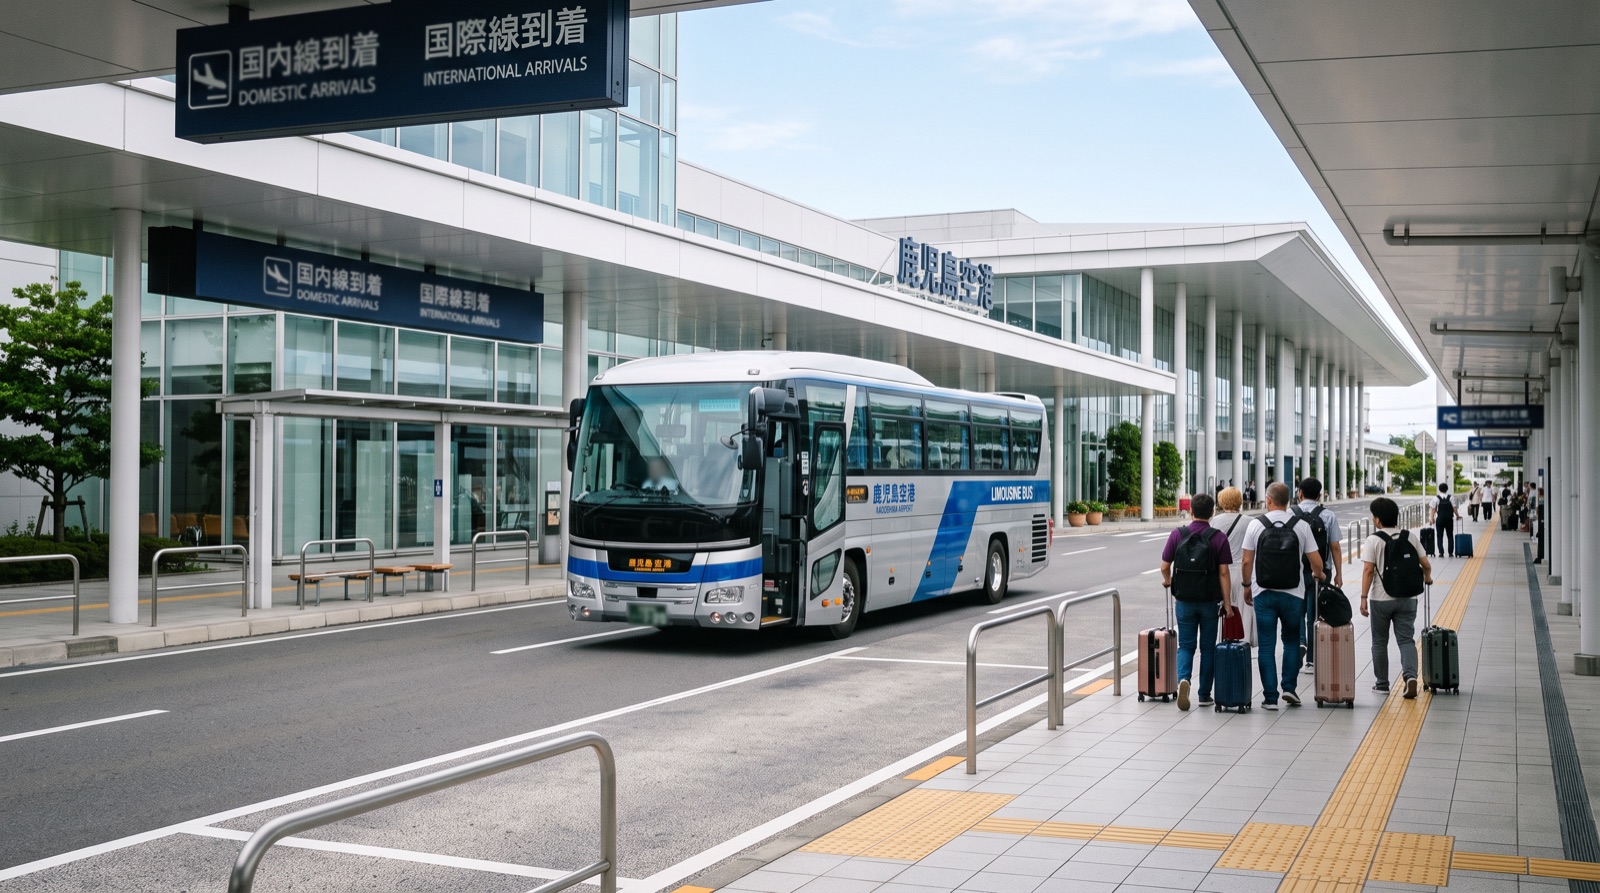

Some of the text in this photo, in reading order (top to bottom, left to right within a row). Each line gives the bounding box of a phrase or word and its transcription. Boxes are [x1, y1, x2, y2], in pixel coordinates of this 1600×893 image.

[425, 5, 588, 60] 国際線到着
[239, 30, 380, 81] 国内線到着
[423, 56, 588, 87] INTERNATIONAL ARRIVALS
[238, 76, 376, 106] DOMESTIC ARRIVALS
[297, 262, 382, 296] 国内線到着
[897, 236, 993, 310] 鹿児島空港
[297, 289, 380, 312] DOMESTIC ARRIVALS
[419, 282, 491, 314] 国際線到着
[420, 307, 470, 324] INTERNATIONAL
[873, 483, 915, 504] 鹿児島空港
[991, 485, 1034, 501] LIMOUSINE BUS
